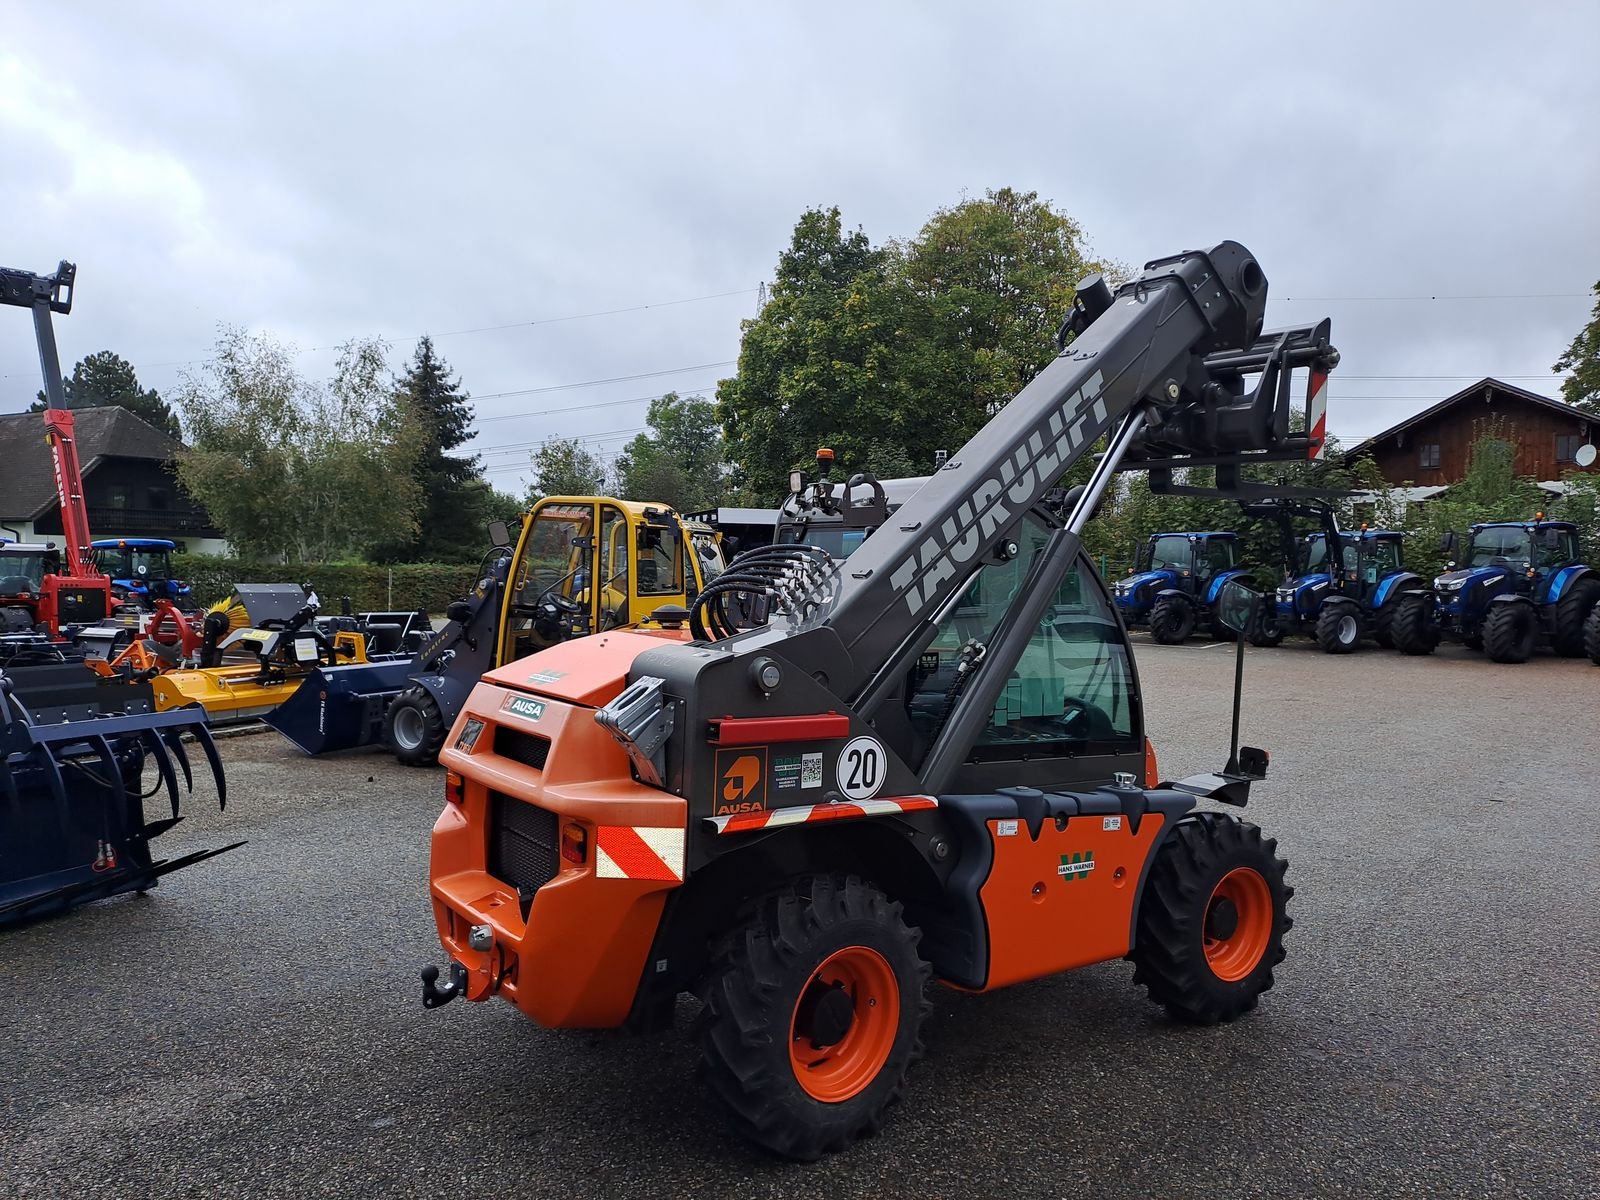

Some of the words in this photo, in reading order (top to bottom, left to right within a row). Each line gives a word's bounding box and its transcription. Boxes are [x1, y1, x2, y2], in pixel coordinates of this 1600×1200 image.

[52, 446, 66, 508] FARESIN
[889, 369, 1108, 616] TAURULIFT
[511, 700, 542, 717] AUSA
[846, 748, 877, 790] 20
[717, 802, 763, 815] AUSA
[1059, 865, 1073, 873] HANS
[1073, 862, 1094, 871] WARNER
